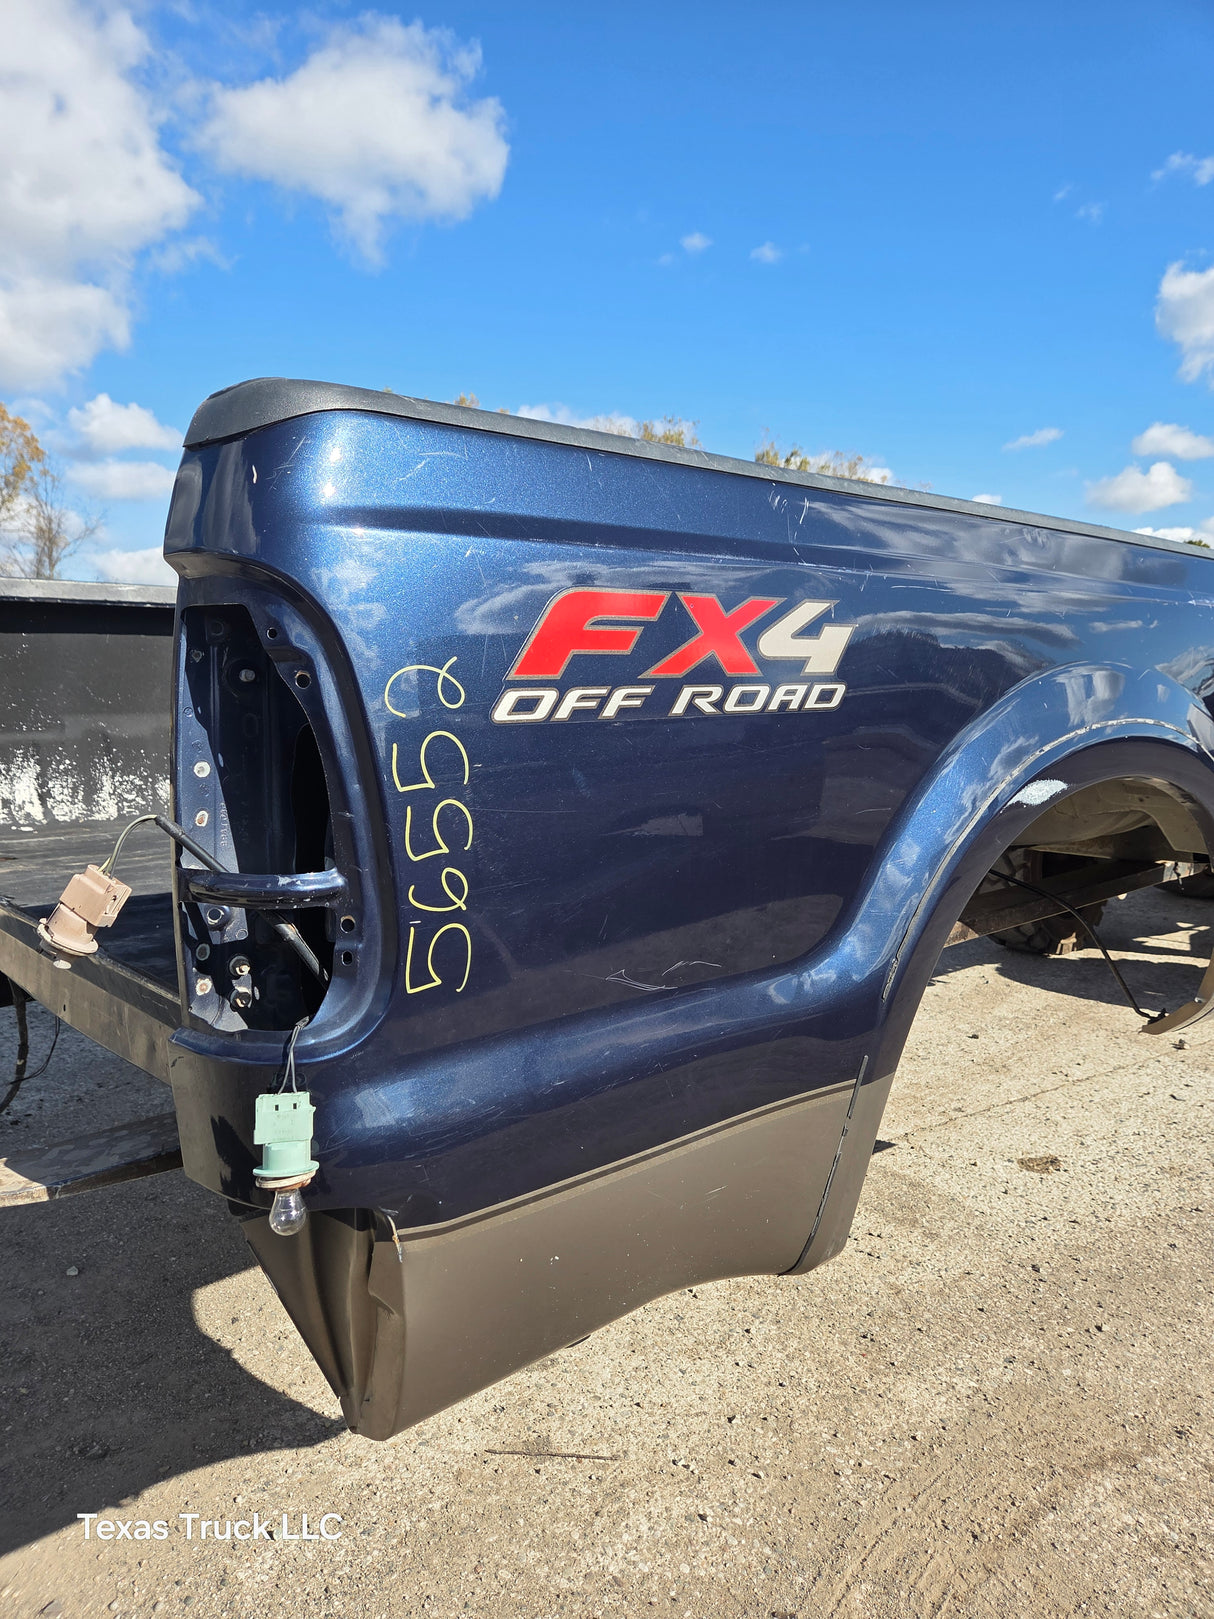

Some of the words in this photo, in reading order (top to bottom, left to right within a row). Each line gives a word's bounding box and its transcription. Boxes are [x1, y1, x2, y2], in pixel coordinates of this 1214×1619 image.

[506, 587, 857, 680] FX4
[492, 685, 654, 722] OFF
[669, 682, 846, 717] ROAD
[384, 656, 474, 994] 56552
